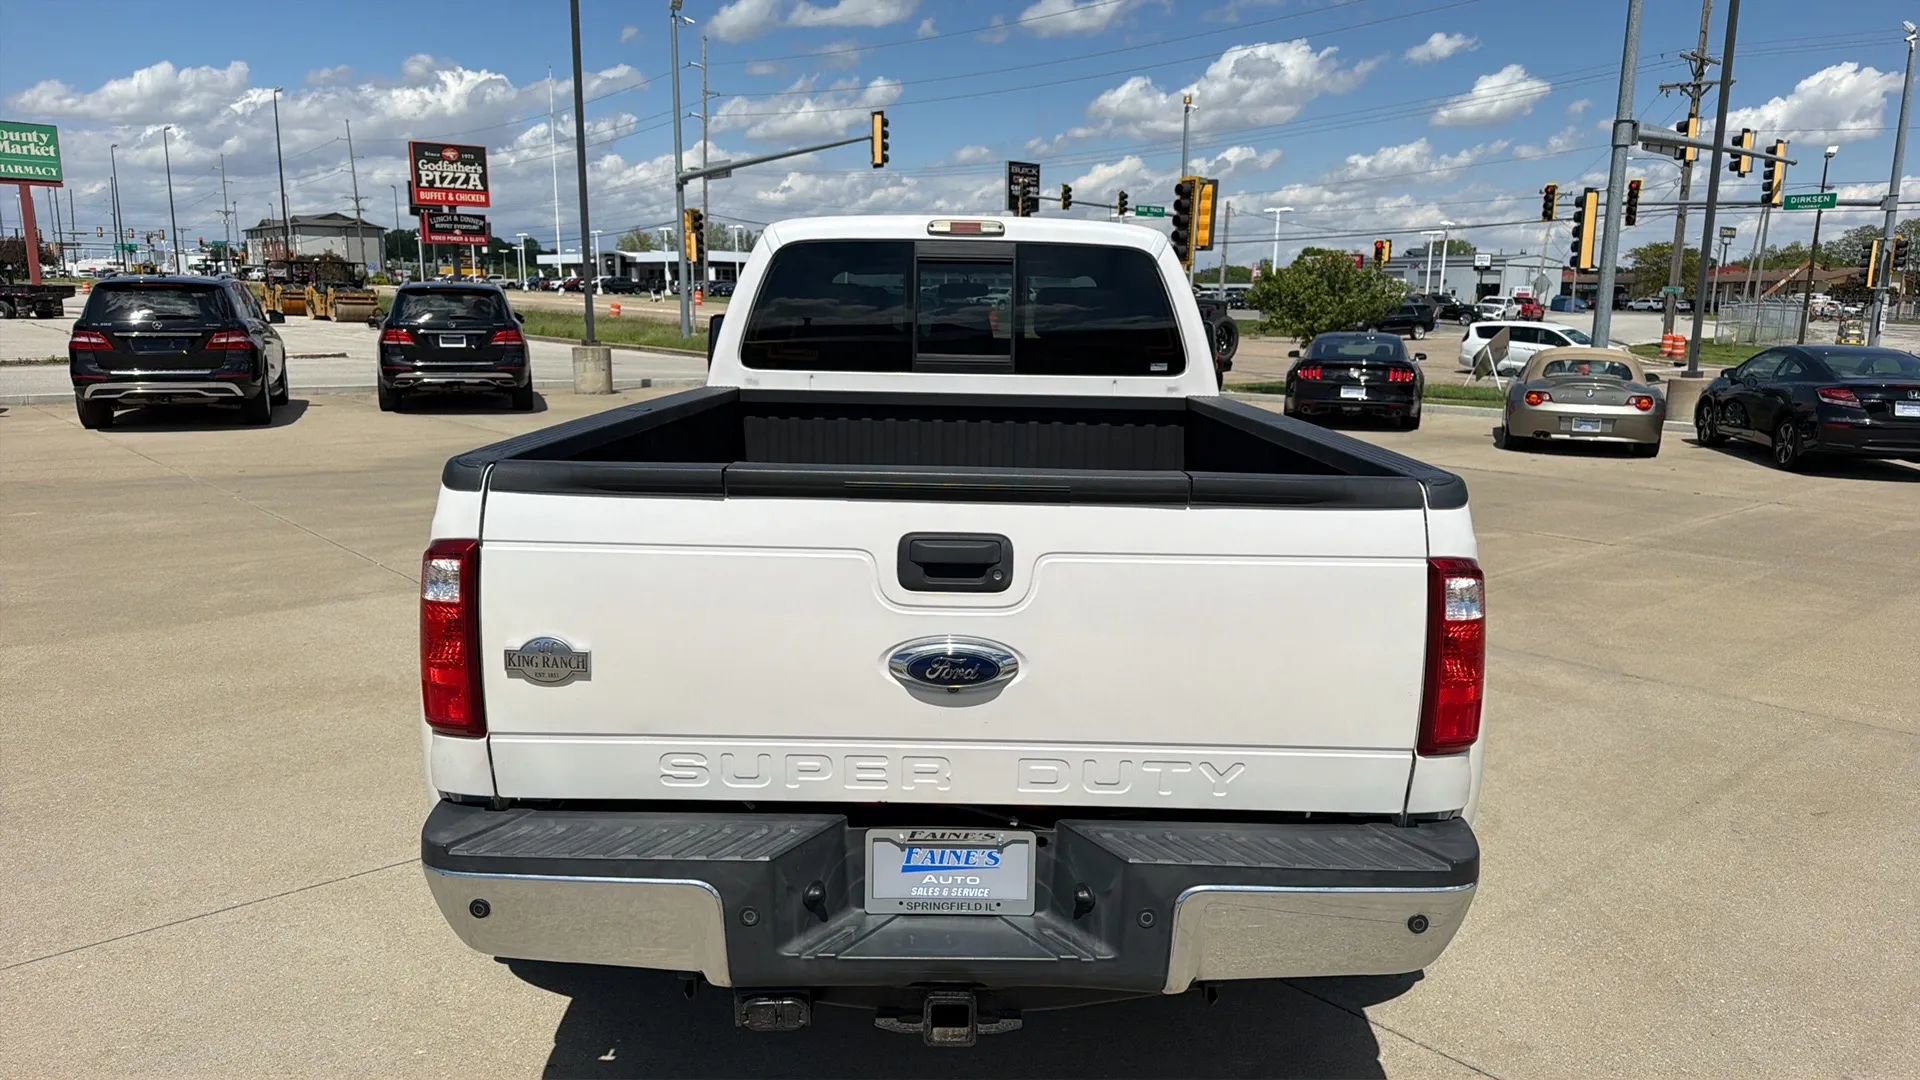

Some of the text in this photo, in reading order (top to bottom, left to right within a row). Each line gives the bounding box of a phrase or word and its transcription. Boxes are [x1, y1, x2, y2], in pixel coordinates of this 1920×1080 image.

[418, 159, 483, 174] Godfather's
[419, 170, 484, 190] PIZZA
[1013, 175, 1038, 185] GC
[420, 191, 486, 203] BUFFET & CHICKEN
[1790, 195, 1830, 204] DIRKSEN
[430, 216, 452, 224] LUNCH
[460, 216, 485, 226] DINNER
[507, 652, 585, 669] KING RANCH
[925, 656, 981, 680] Ford
[659, 752, 1246, 797] SUPER DUTY
[906, 830, 996, 842] FAINE'S
[902, 848, 1001, 867] FAINE'S
[922, 874, 981, 885] AUTO
[911, 887, 990, 897] SALES & SERVICE
[906, 902, 995, 912] SPRINGFIELD IL
